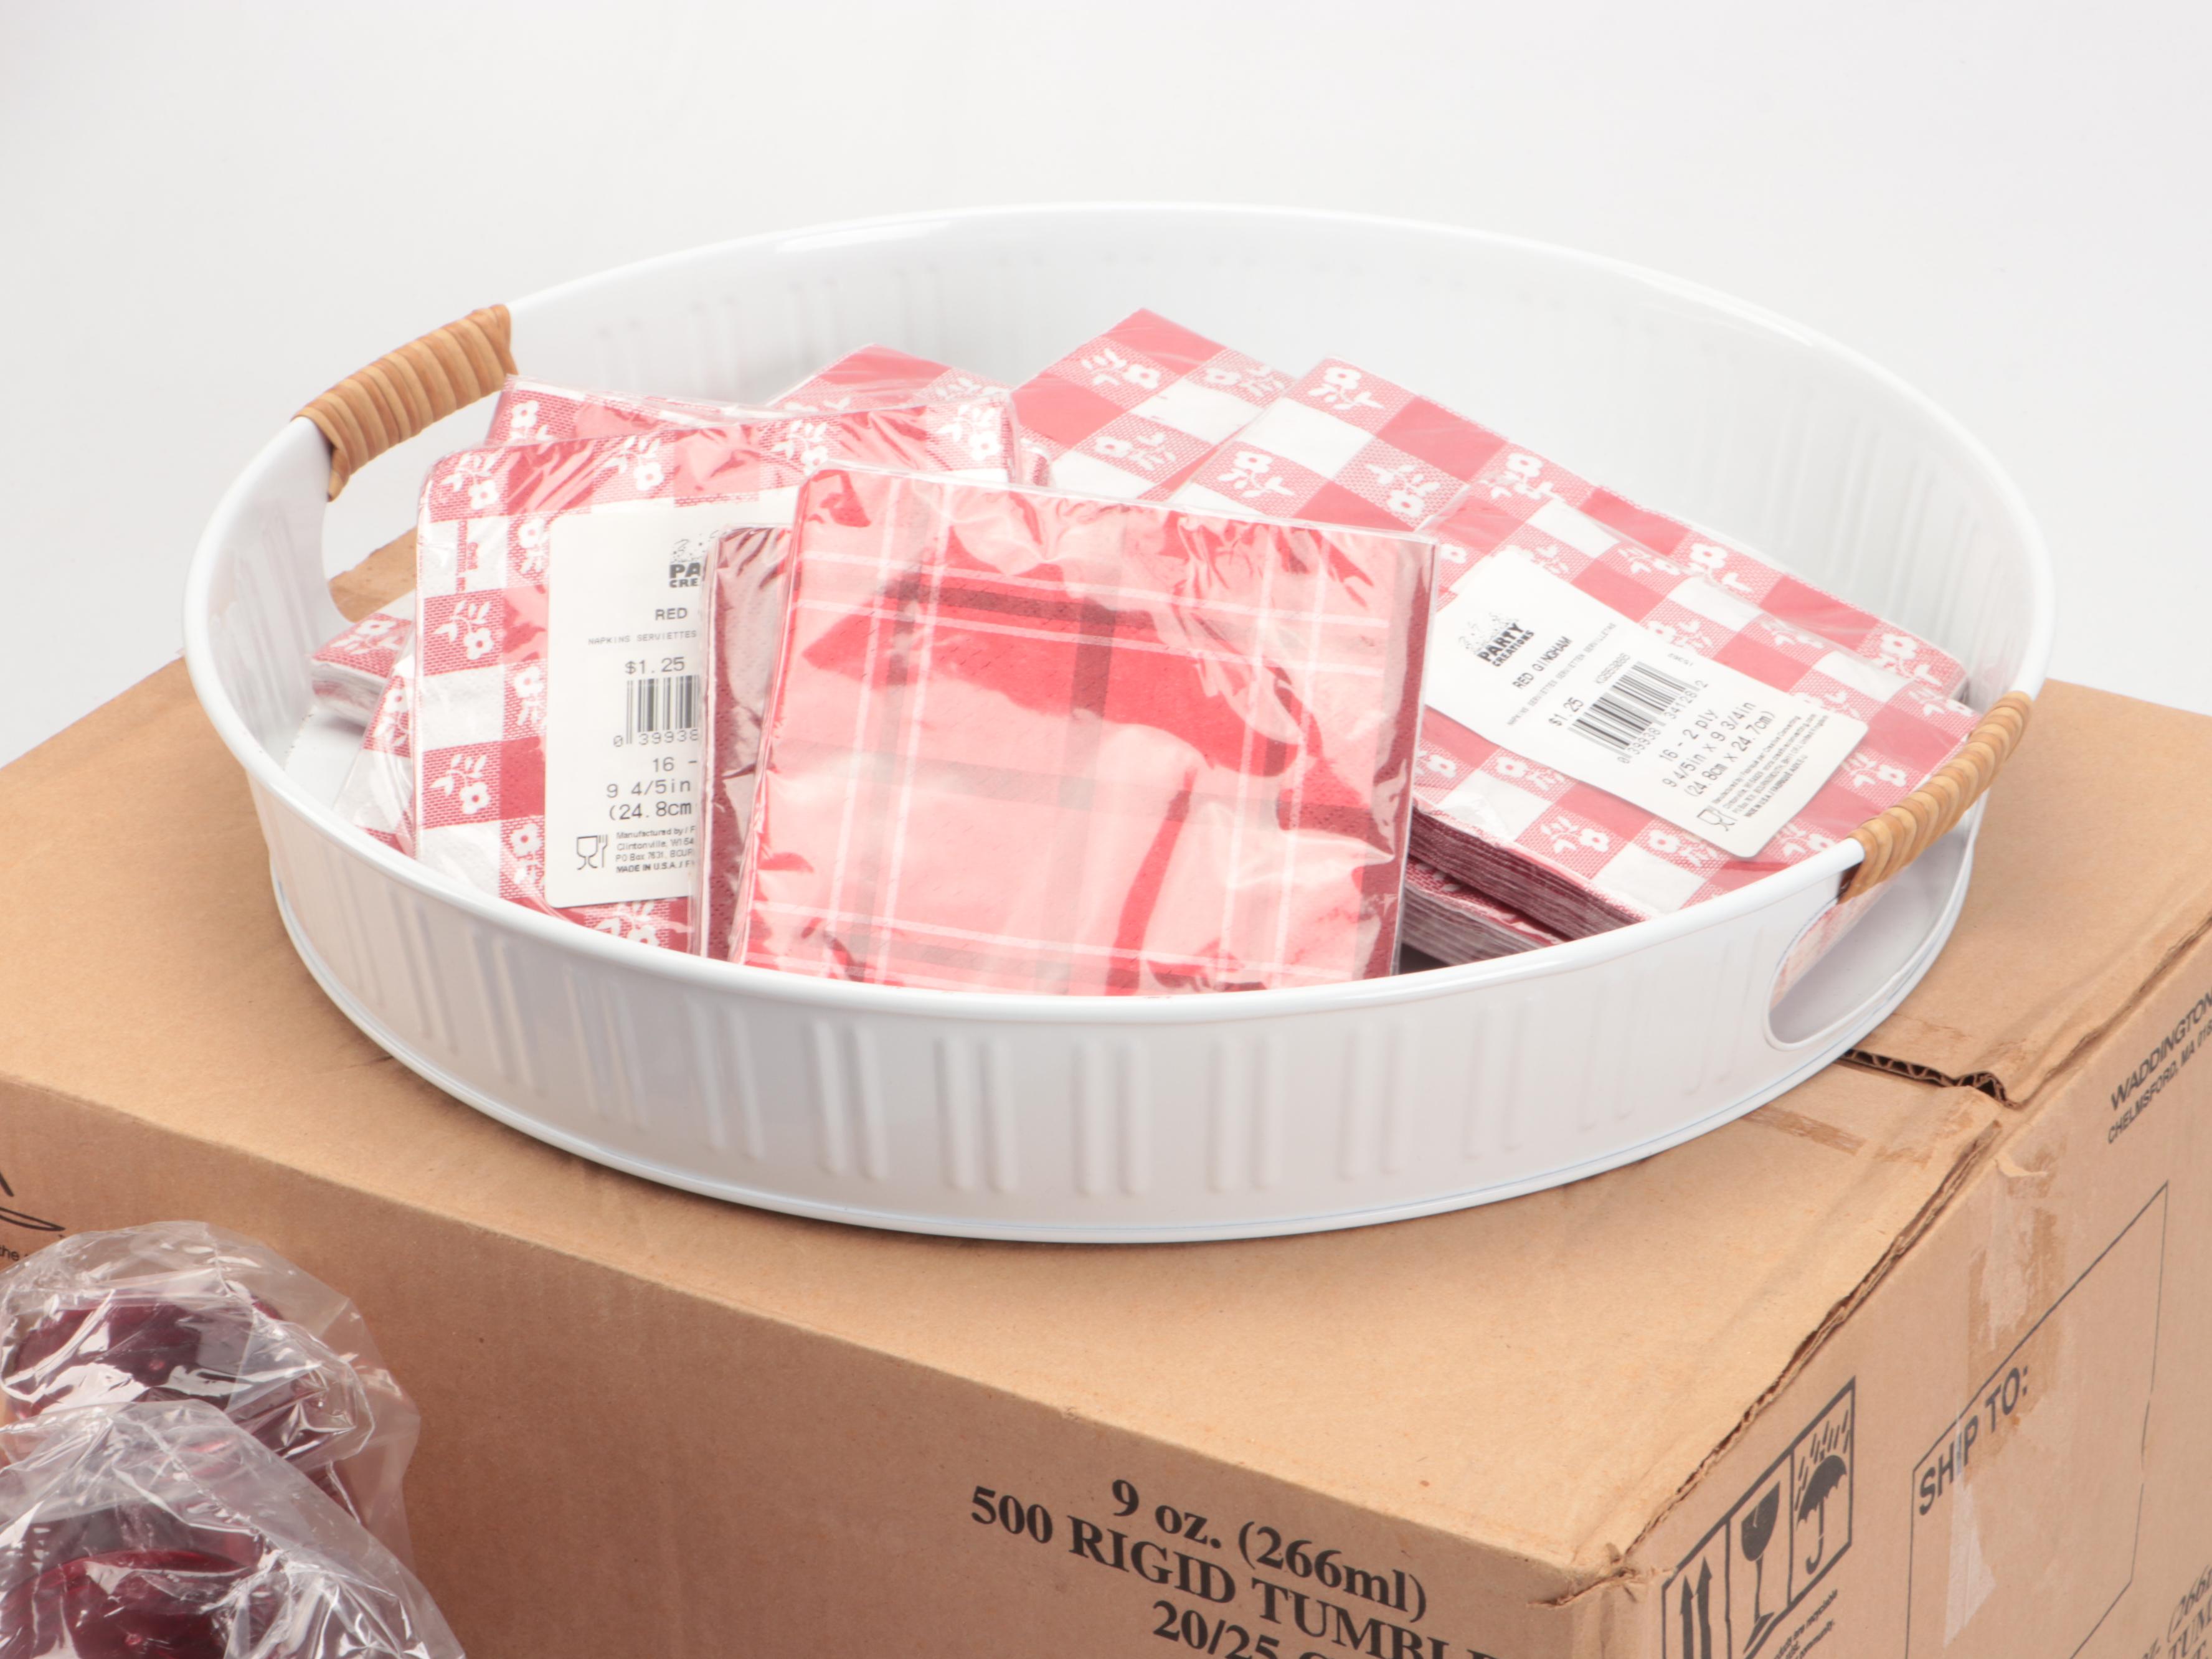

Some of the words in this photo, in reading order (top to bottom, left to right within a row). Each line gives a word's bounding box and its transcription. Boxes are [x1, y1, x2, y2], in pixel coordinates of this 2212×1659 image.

[655, 607, 688, 621] RED
[588, 635, 631, 645] NAPKINS
[636, 630, 697, 642] SERVIETTES
[1477, 622, 1524, 663] PARTY
[1491, 630, 1534, 667] CREATIONS
[625, 656, 685, 675] $1.25
[1511, 672, 1534, 689] RED
[1531, 636, 1572, 672] GINGHAM
[1548, 697, 1584, 727] $1.25
[1658, 749, 1679, 762] 16
[1682, 729, 1699, 740] 2
[1694, 709, 1718, 730] ply
[1661, 778, 1678, 788] 9
[1673, 754, 1706, 780] 4/5in
[1702, 743, 1717, 753] x
[1710, 731, 1726, 742] 9
[1720, 702, 1756, 730] 3/4in
[653, 757, 674, 772] 16
[1723, 752, 1738, 763] x
[607, 783, 618, 798] 9
[631, 779, 691, 796] 4/5in
[609, 801, 692, 821] (24.8cm
[617, 864, 640, 873] MADE
[2180, 1039, 2195, 1067] MA
[1919, 1415, 1979, 1516] SHIP
[1985, 1365, 2028, 1434] TO:
[1112, 1478, 1140, 1517] 9
[1155, 1505, 1222, 1549] oz.
[1238, 1521, 1427, 1623] (266ml)
[970, 1485, 1054, 1544] 500
[1067, 1515, 1237, 1604] RIGID
[1250, 1577, 1498, 1659] TUMBL
[1153, 1600, 1280, 1659] 20/25
